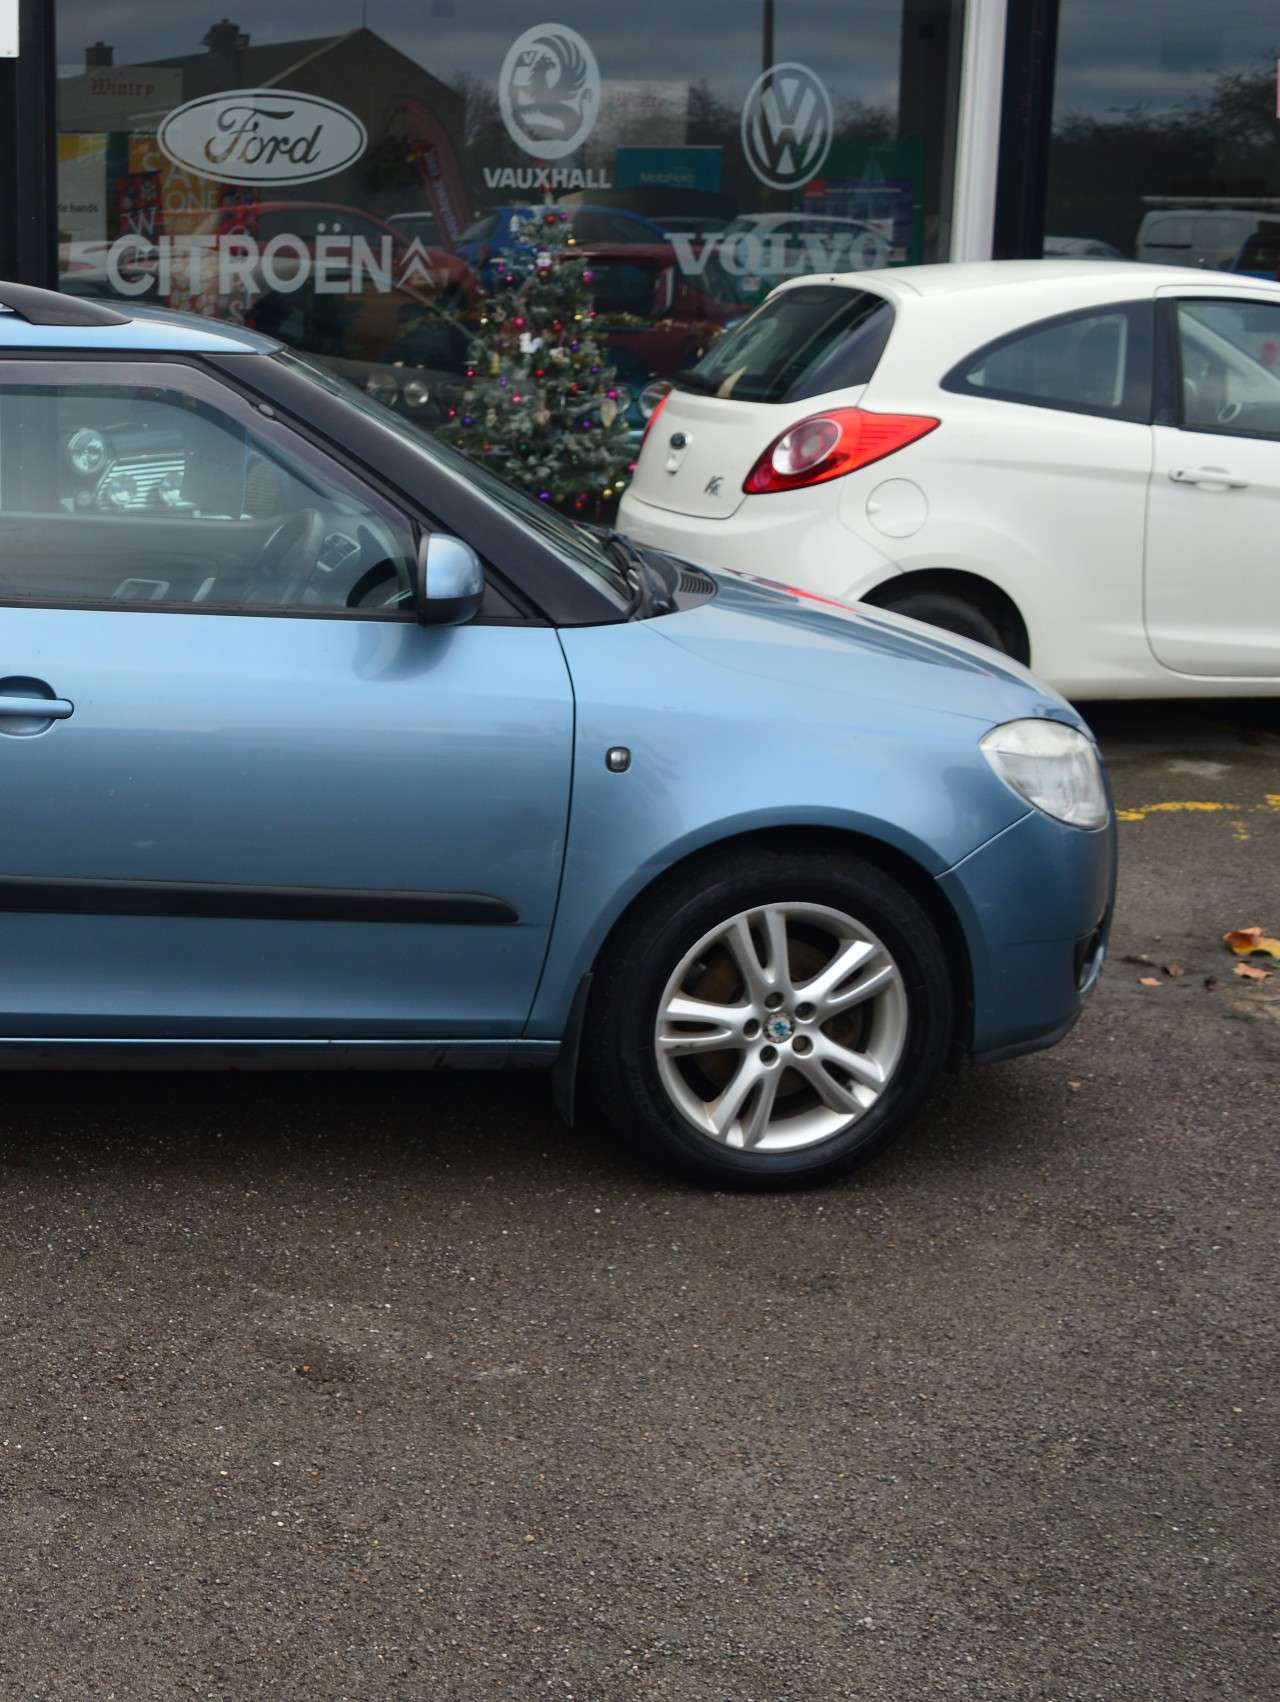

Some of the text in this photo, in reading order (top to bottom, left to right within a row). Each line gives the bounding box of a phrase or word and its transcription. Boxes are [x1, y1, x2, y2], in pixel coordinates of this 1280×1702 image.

[204, 105, 322, 165] Ford
[483, 167, 612, 190] VAUXHALL
[106, 222, 392, 295] CITROËN
[665, 232, 890, 276] VOLVO
